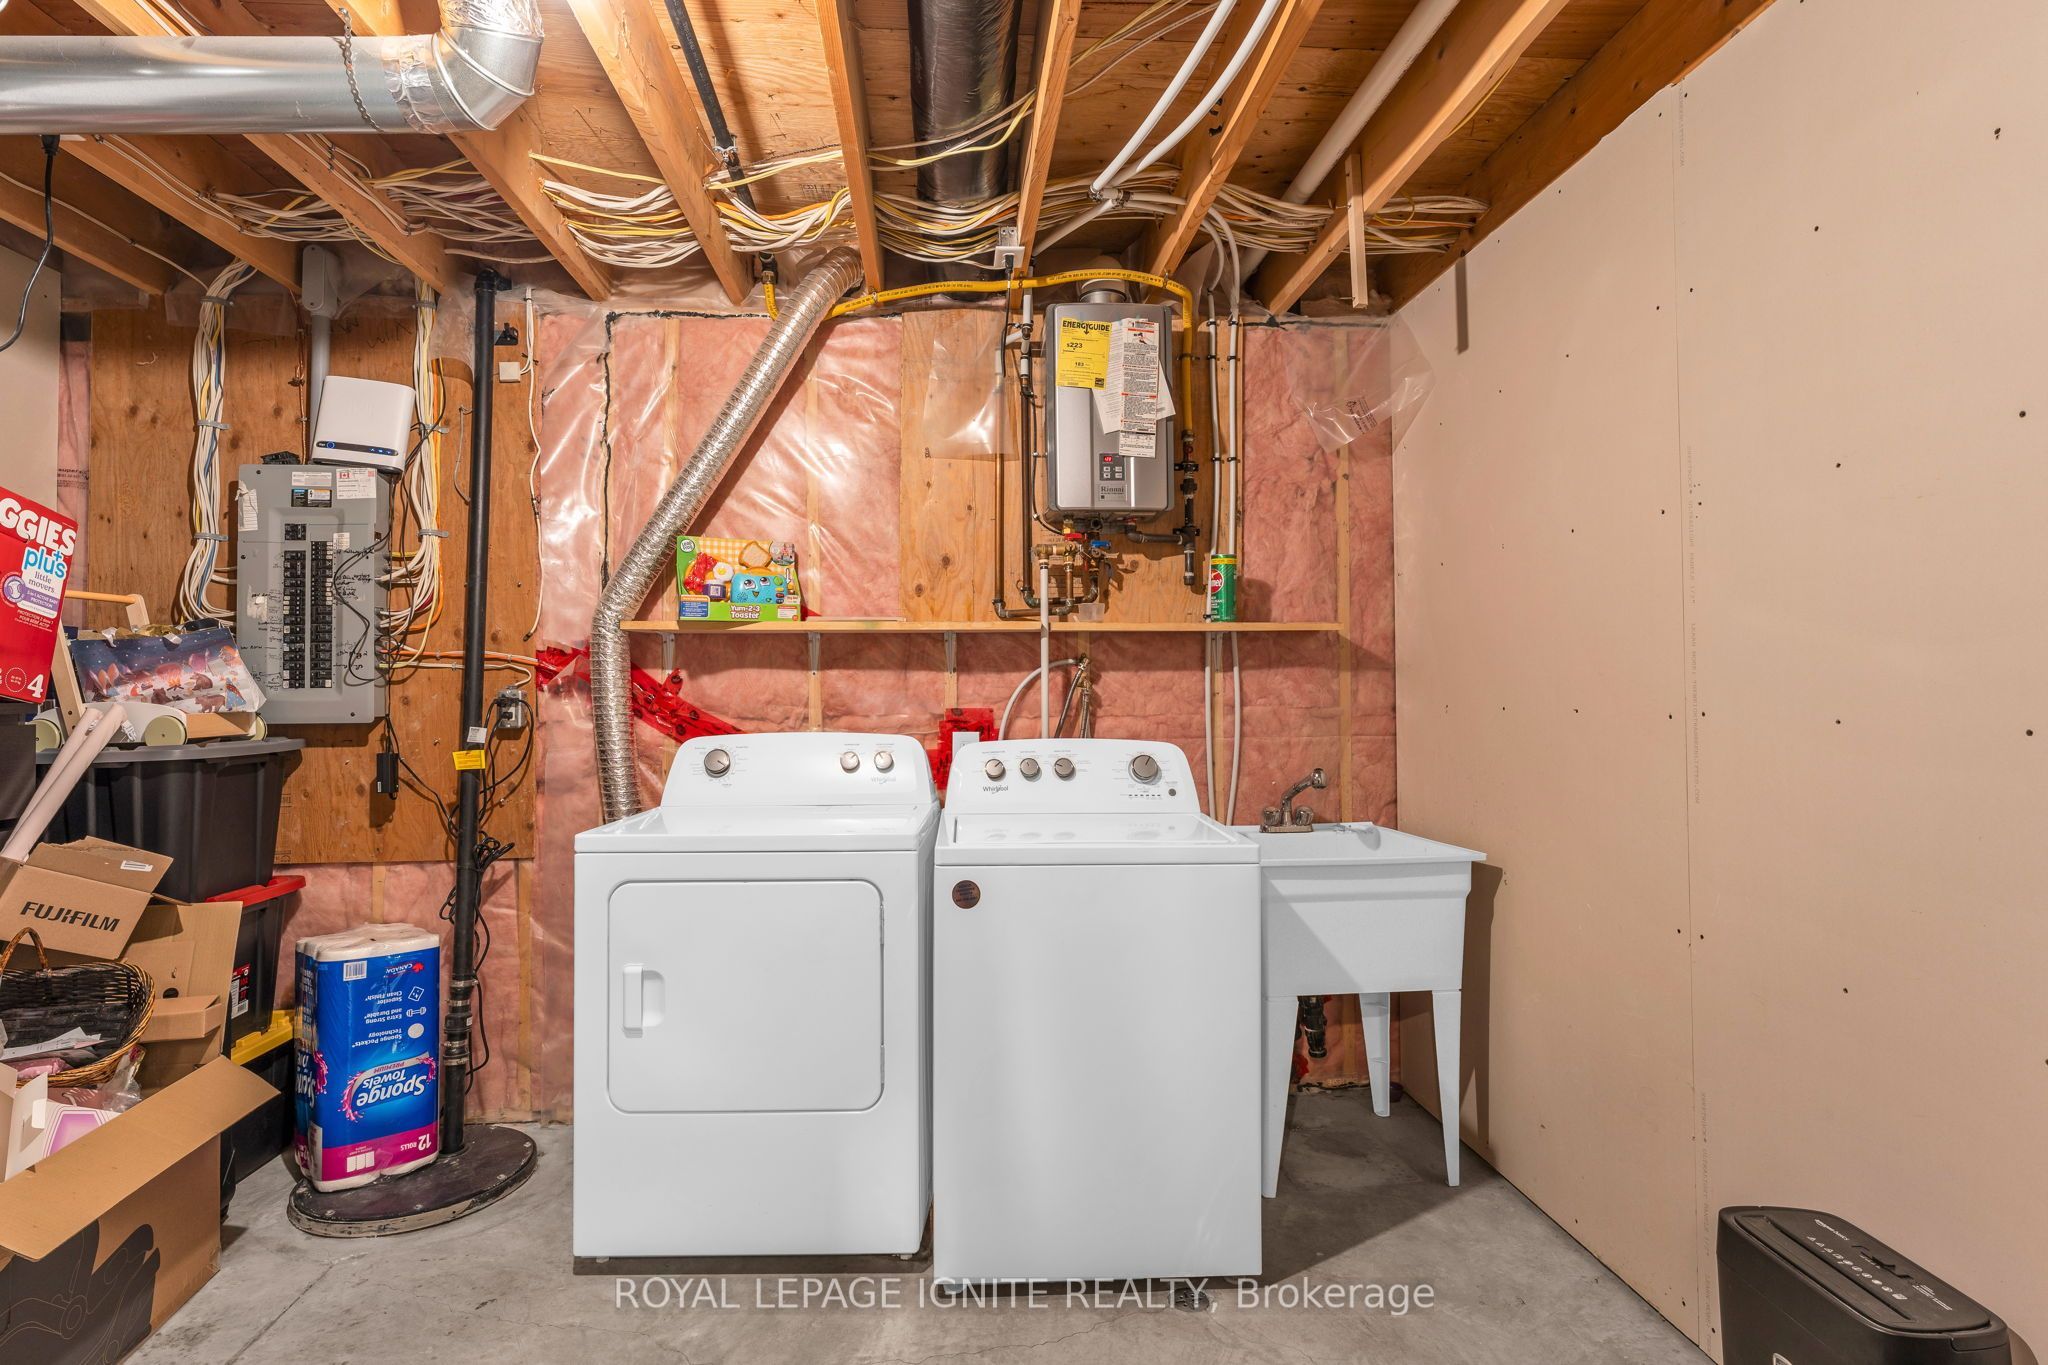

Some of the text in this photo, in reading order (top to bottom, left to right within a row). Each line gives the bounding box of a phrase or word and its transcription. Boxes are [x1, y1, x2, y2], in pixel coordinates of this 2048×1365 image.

[1101, 485, 1124, 493] Rinnai
[24, 548, 66, 579] plus
[29, 579, 55, 593] movers
[34, 571, 52, 585] little
[730, 611, 760, 619] Toaster
[27, 674, 44, 698] 4
[20, 901, 120, 932] FUJIFILM
[362, 1069, 407, 1089] Towels
[356, 1074, 427, 1107] Sponge
[418, 1133, 432, 1151] 12
